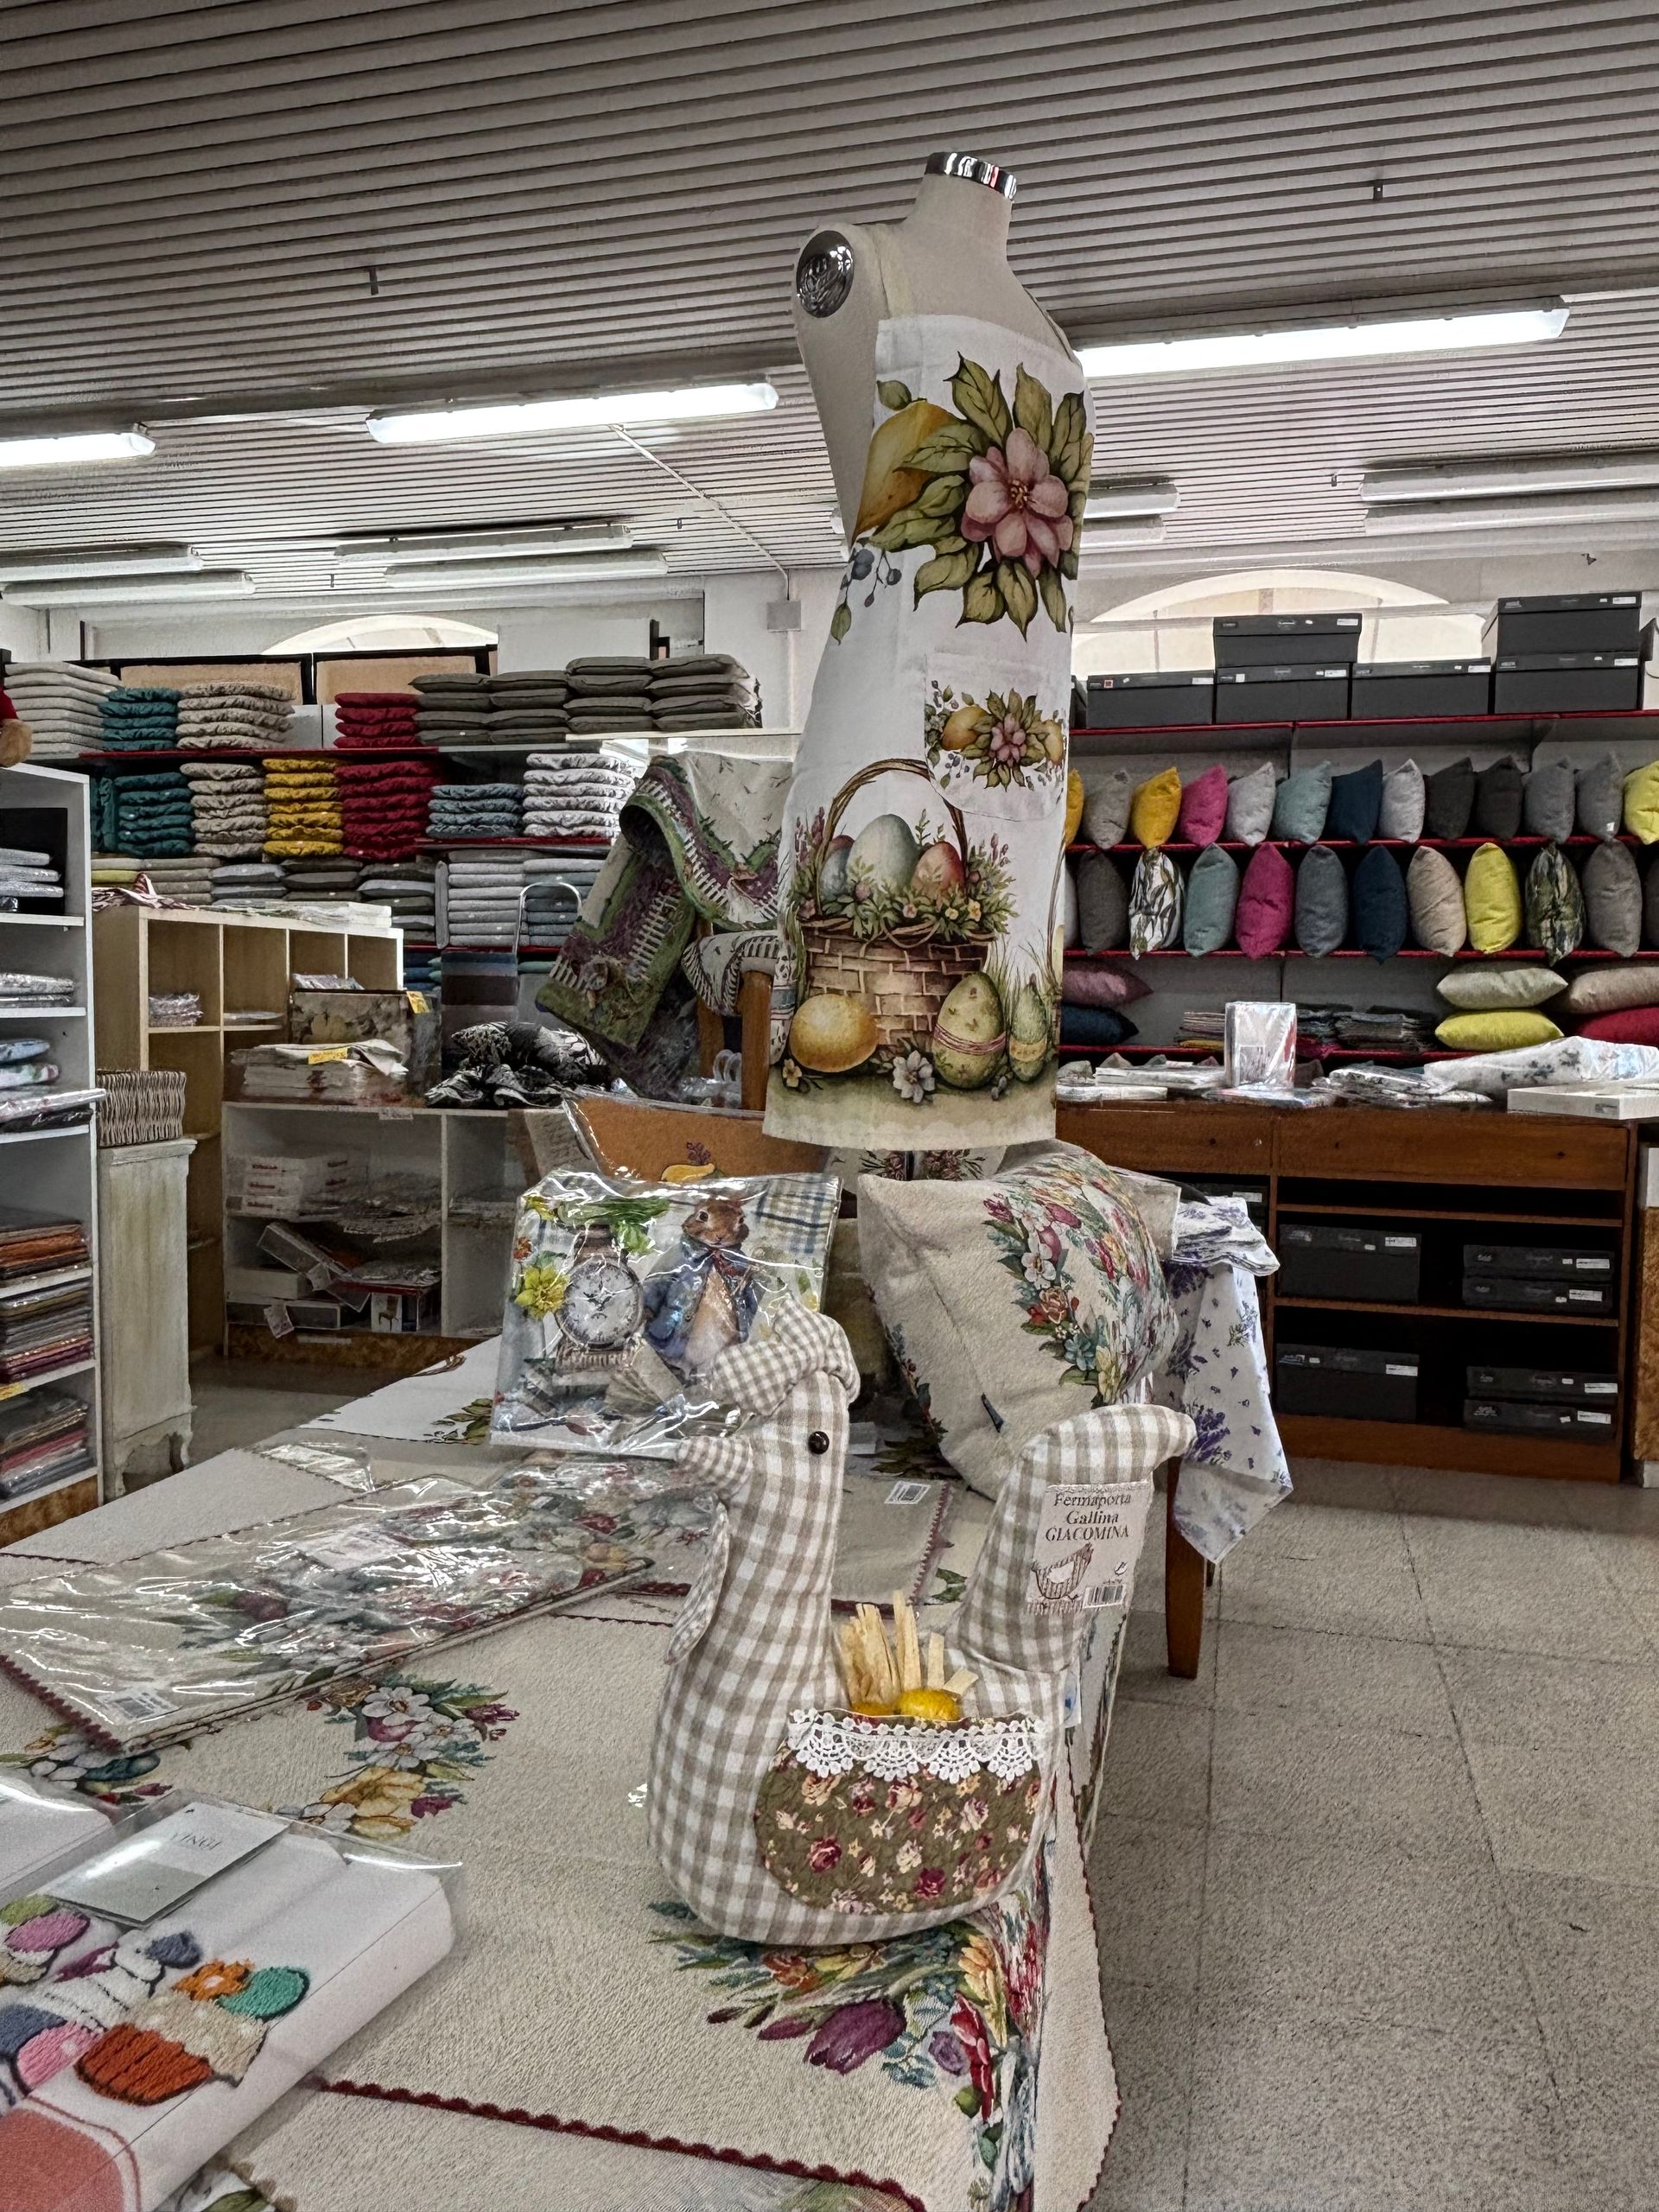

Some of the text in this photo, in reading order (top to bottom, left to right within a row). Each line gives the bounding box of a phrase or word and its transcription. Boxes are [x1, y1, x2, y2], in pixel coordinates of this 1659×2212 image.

[1053, 1493, 1131, 1510] Fermaporta
[1066, 1510, 1119, 1525] Gallina
[1045, 1525, 1129, 1541] GIACOMINA
